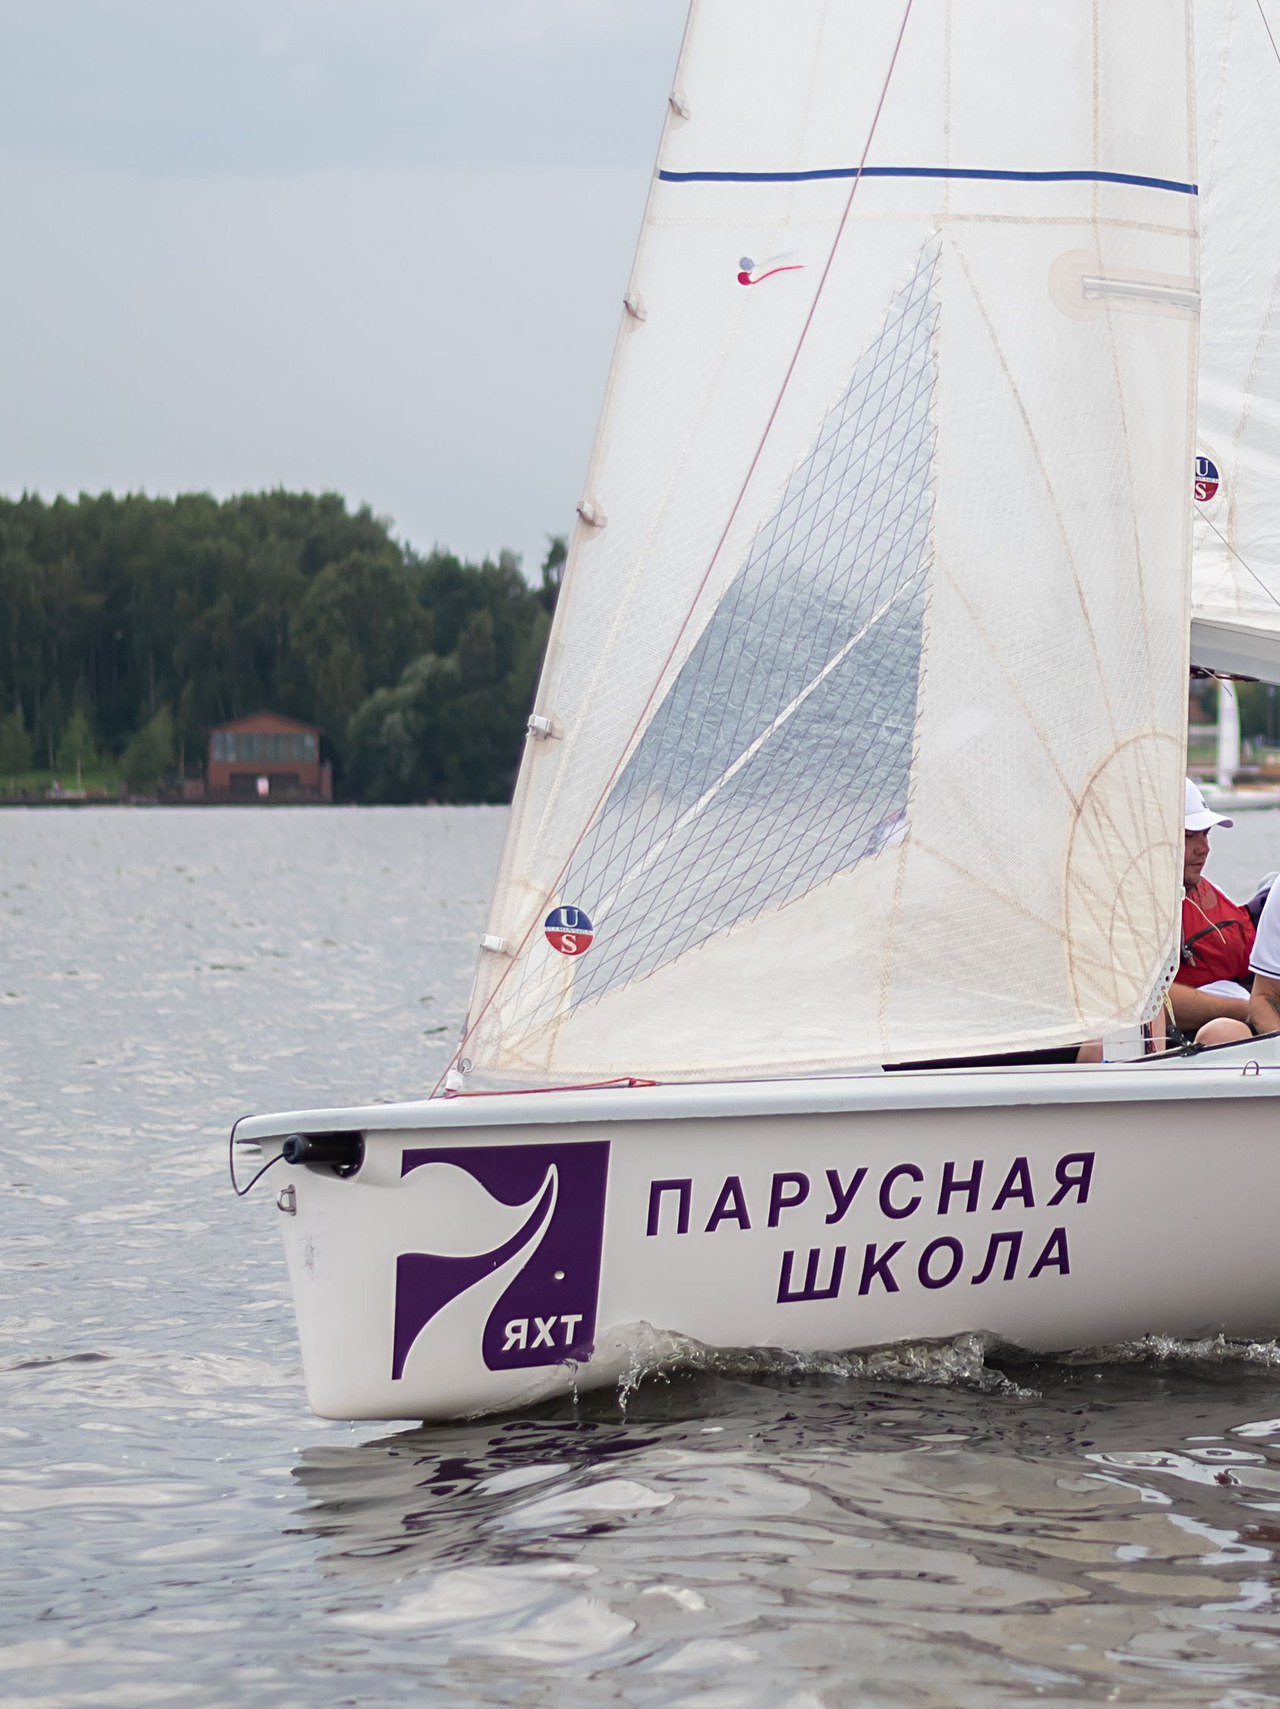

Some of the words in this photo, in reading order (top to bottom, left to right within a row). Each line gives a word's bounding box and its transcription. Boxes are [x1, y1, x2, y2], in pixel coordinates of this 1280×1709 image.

[646, 1151, 1096, 1237] ПАРУСНАЯ
[776, 1226, 1071, 1304] ШКОЛА
[501, 1313, 583, 1351] ЯХТ
